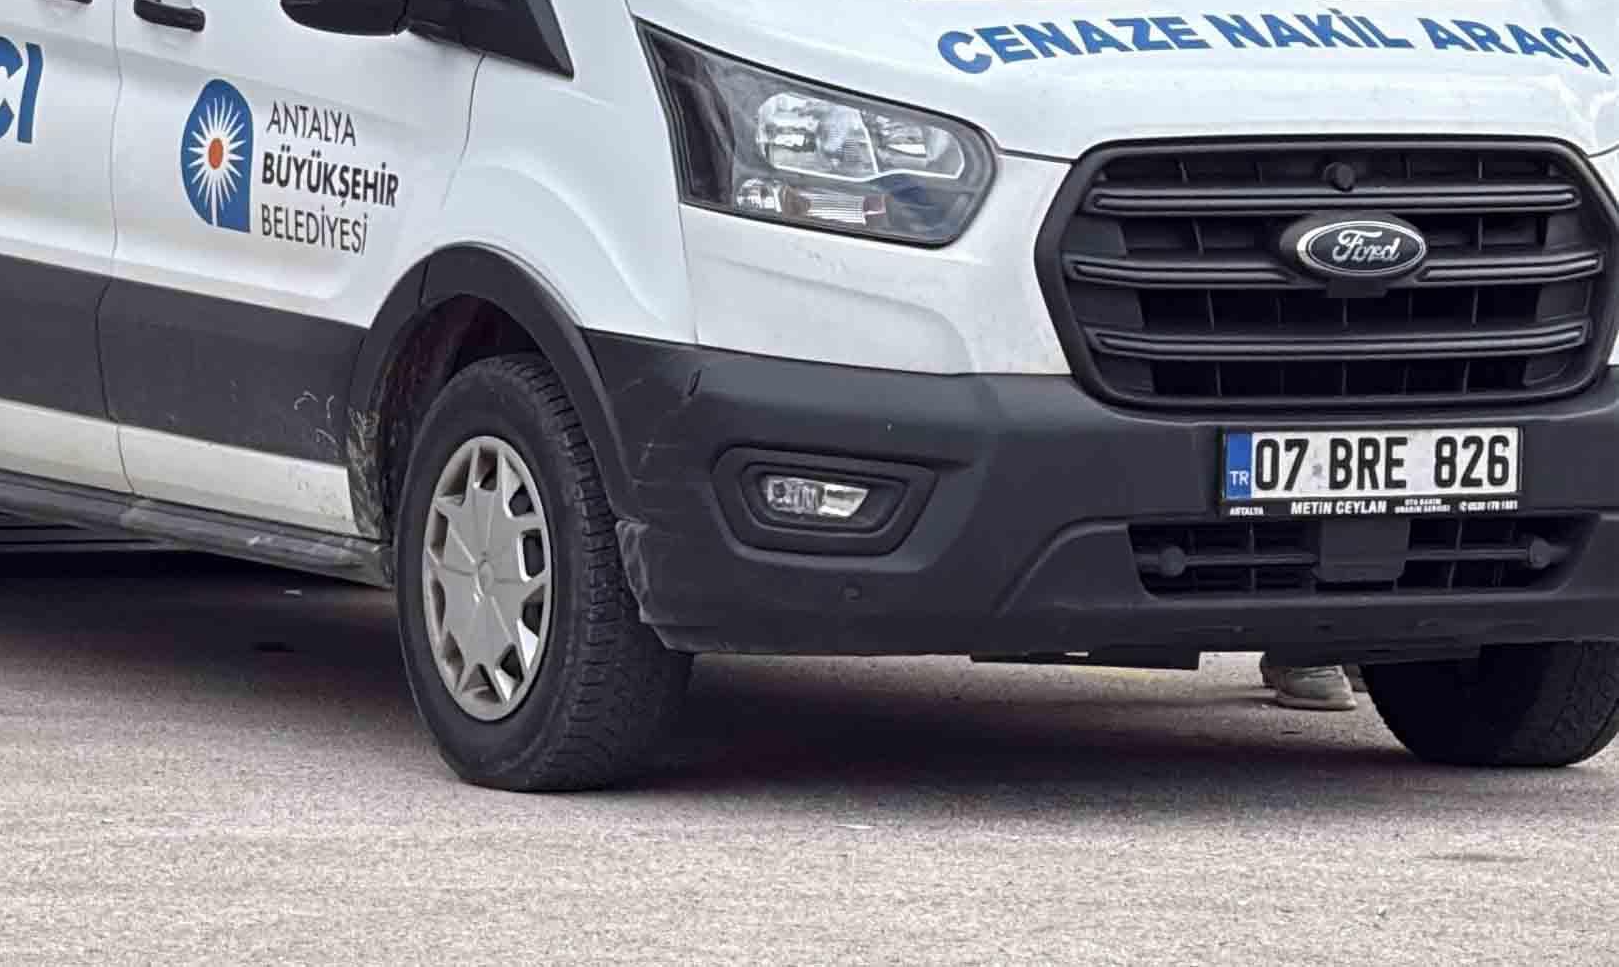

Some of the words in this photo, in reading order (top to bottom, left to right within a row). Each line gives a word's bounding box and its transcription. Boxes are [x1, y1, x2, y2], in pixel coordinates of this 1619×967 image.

[937, 16, 1212, 75] CENAZE
[1202, 7, 1415, 49] NAKİL
[1417, 17, 1611, 75] ARACI
[266, 100, 356, 146] ANTALYA
[261, 143, 399, 209] BÜYÜKŞEHİR
[261, 203, 368, 255] BELEDİYESİ
[1332, 229, 1401, 262] Ford
[1229, 470, 1250, 486] TR
[1255, 437, 1310, 491] 07
[1328, 436, 1409, 490] BRE
[1434, 435, 1510, 488] 826
[1335, 499, 1387, 515] CEYLAN
